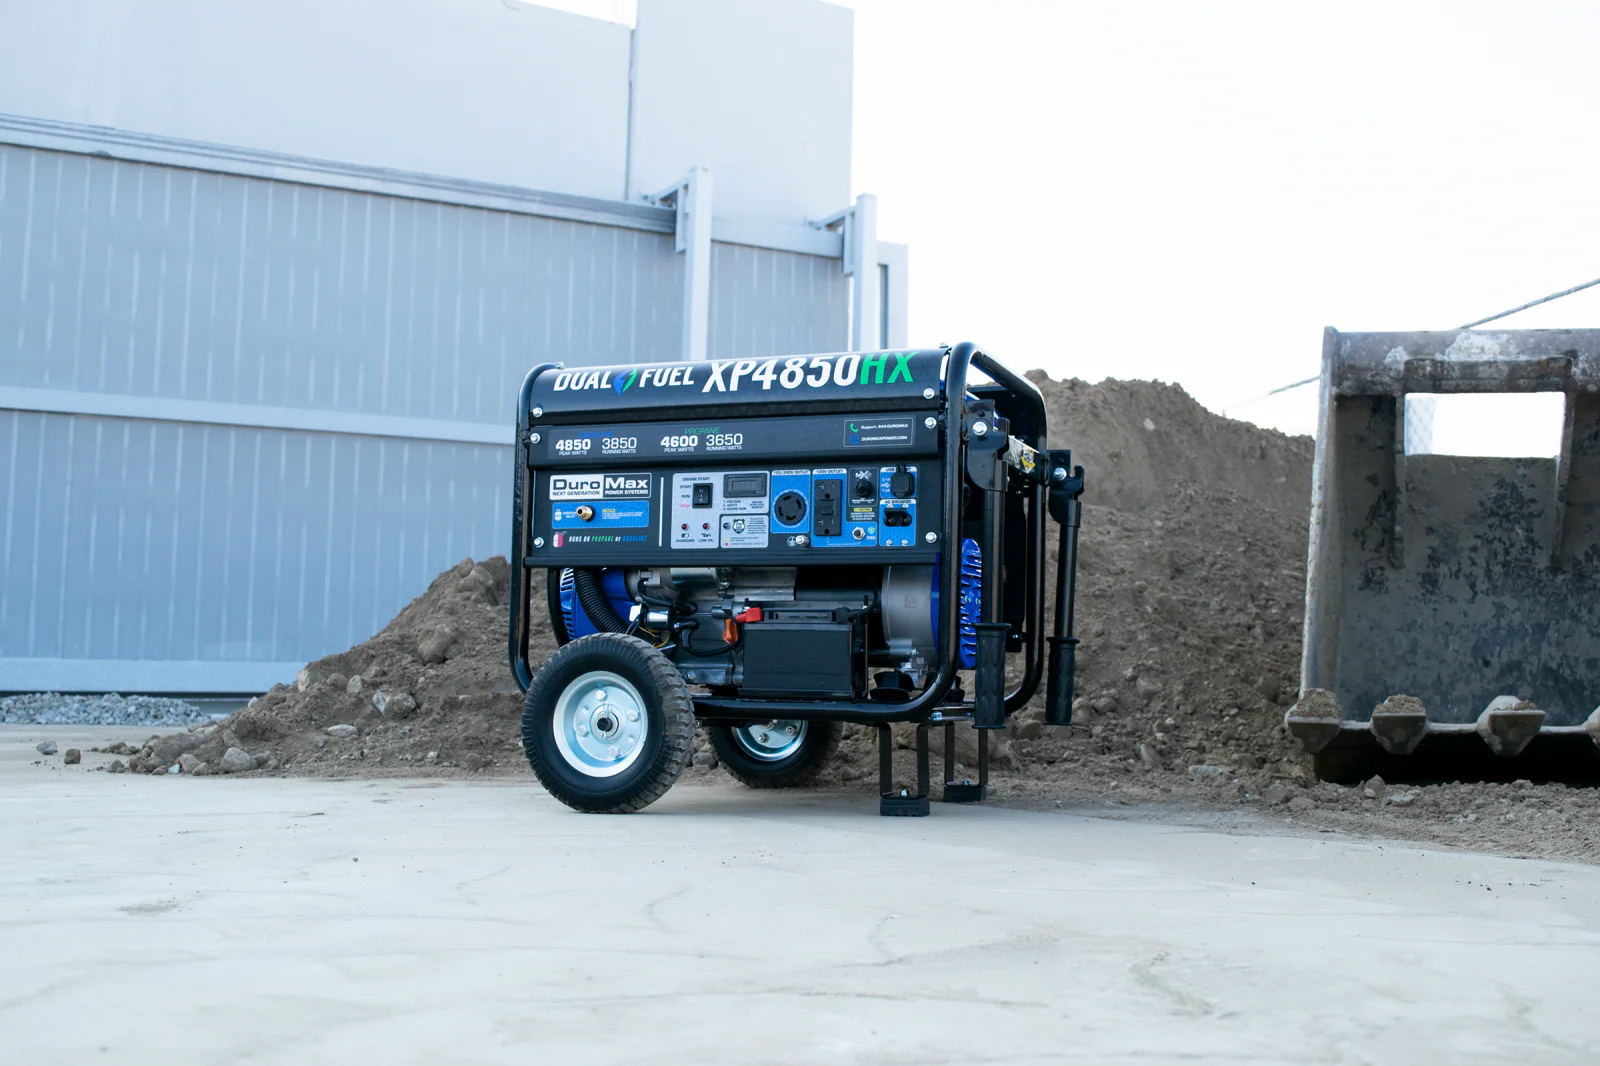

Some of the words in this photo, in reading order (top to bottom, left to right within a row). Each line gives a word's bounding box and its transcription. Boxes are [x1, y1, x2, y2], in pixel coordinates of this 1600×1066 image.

[701, 351, 919, 393] XP4850HX
[553, 370, 612, 392] DUAL
[639, 366, 695, 388] FUEL
[578, 430, 614, 439] GASOLINE
[684, 427, 720, 435] PROPANE
[555, 438, 591, 451] 4850
[601, 437, 637, 450] 3850
[660, 435, 698, 448] 4600
[705, 433, 743, 447] 3650
[553, 479, 600, 490] Duro
[605, 477, 648, 489] Max
[591, 535, 614, 543] PROPANE
